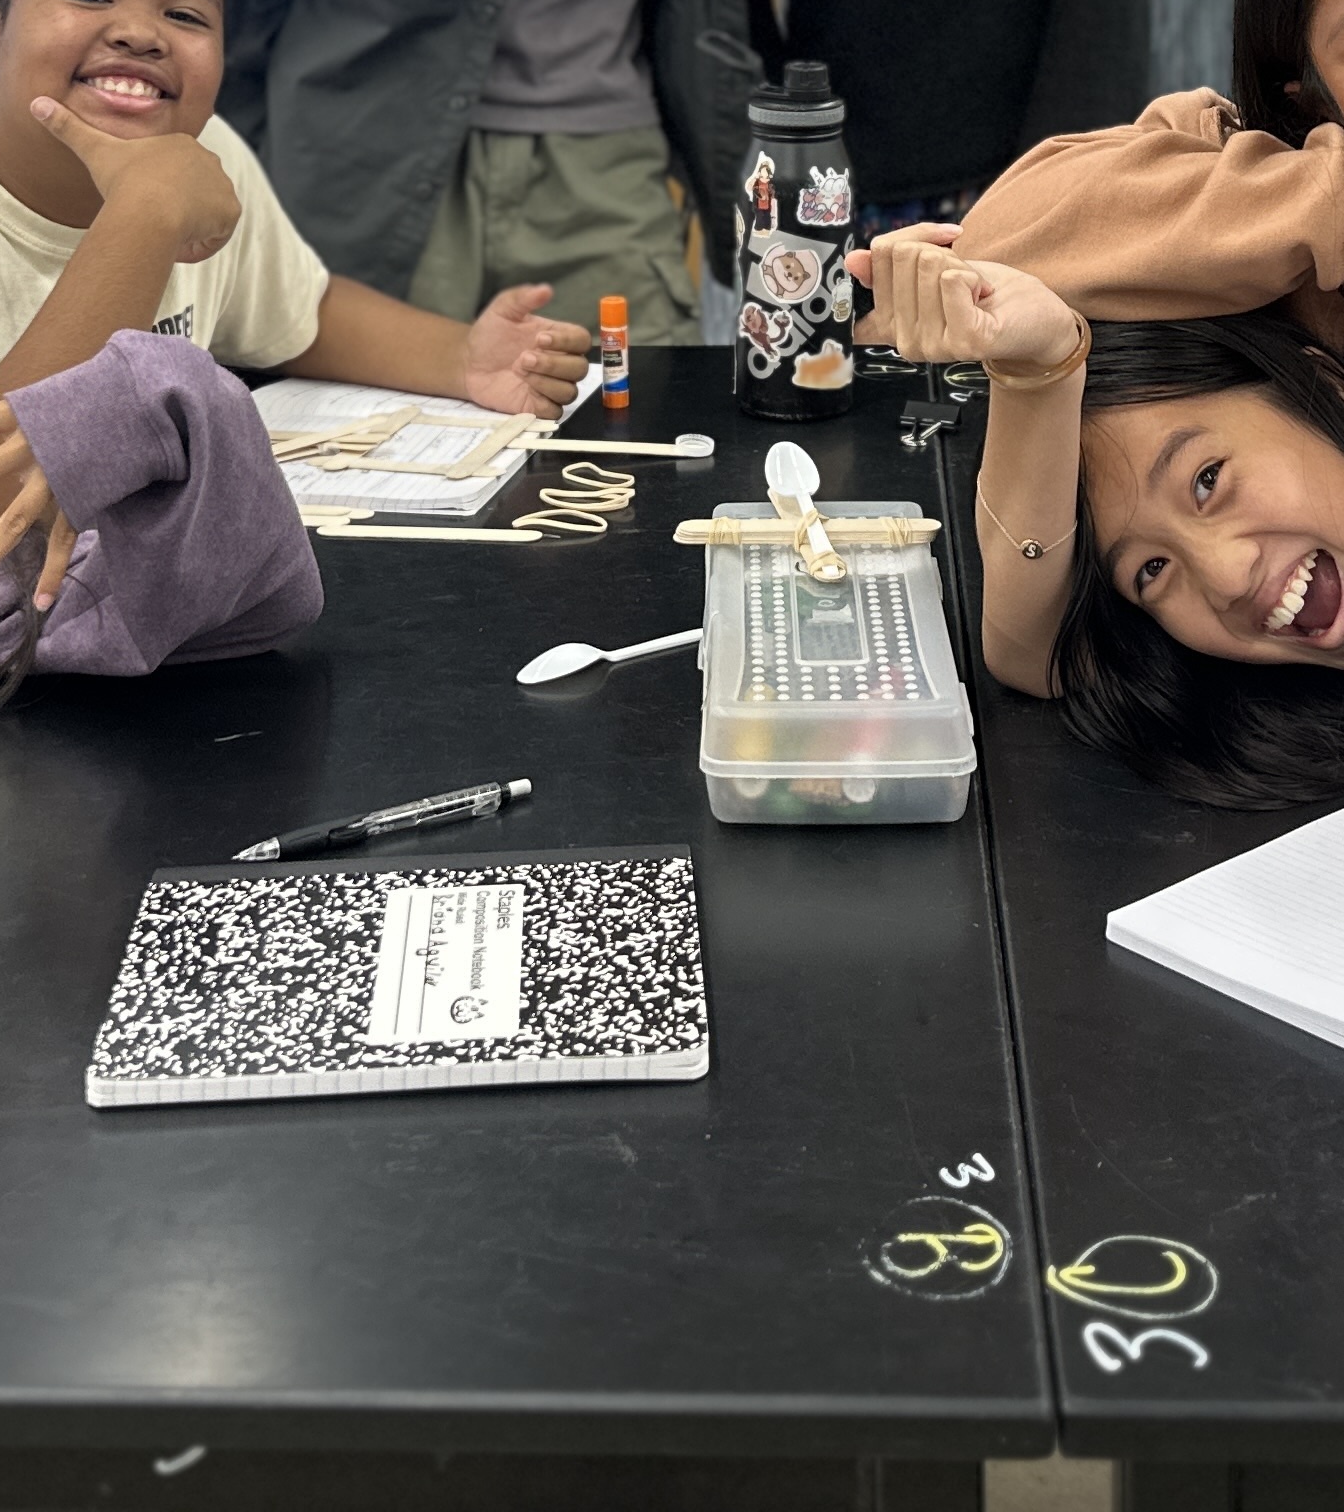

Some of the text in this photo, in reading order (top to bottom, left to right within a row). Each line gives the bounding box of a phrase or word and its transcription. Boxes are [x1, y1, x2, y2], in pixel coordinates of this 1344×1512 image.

[470, 890, 492, 991] Composition Notebook
[493, 889, 517, 931] Staples
